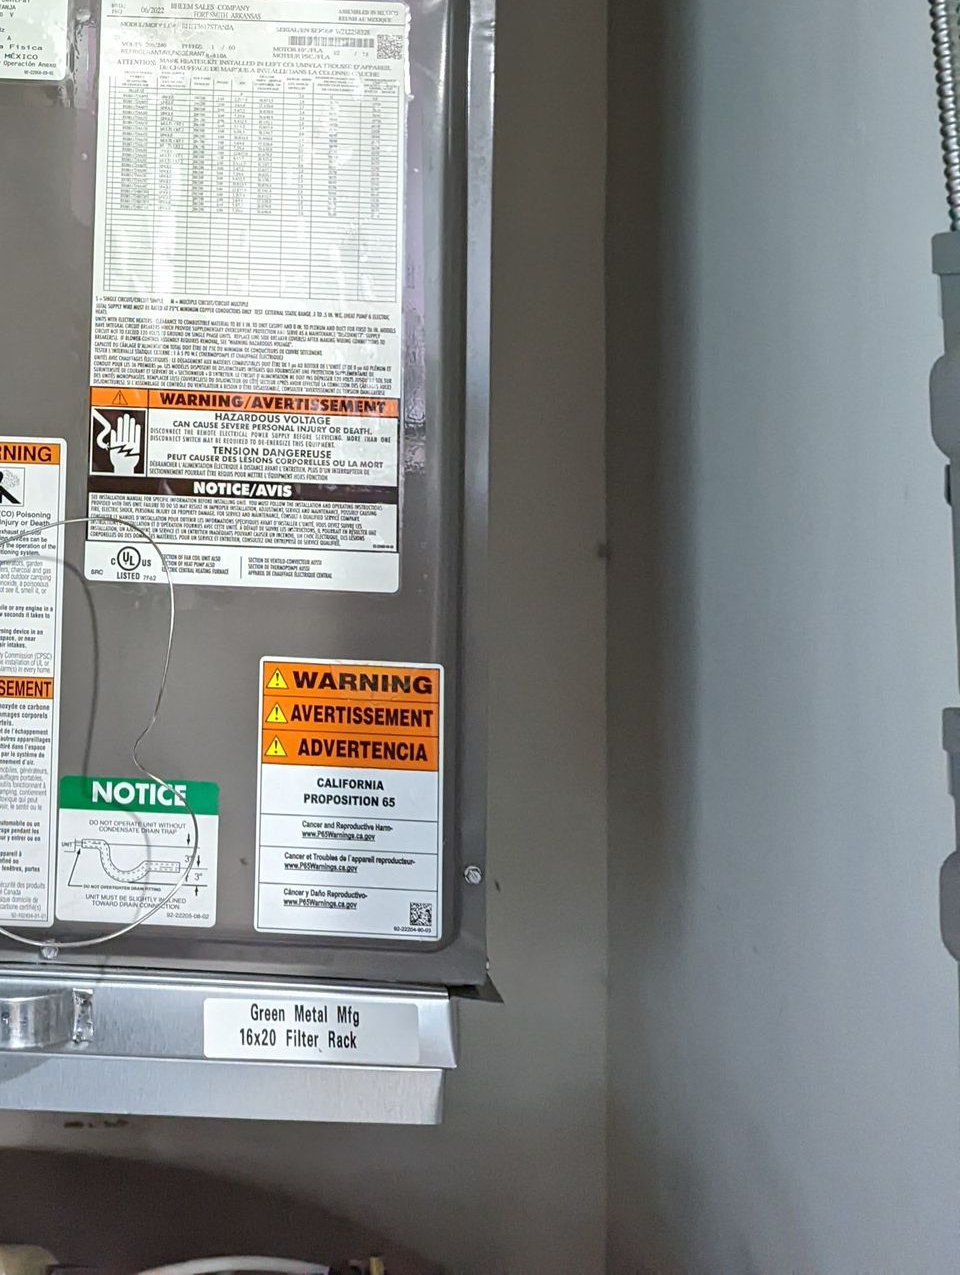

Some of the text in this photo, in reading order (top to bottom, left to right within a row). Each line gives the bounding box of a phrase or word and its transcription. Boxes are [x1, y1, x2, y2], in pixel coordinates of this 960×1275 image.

[160, 393, 386, 413] WARNING/AVERTISSEMENT
[214, 413, 330, 425] HAZARDOUS VOLTAGE
[220, 422, 249, 430] SEVERE
[252, 423, 294, 431] PERSONAL
[297, 425, 326, 433] INJURY
[213, 446, 331, 459] TENSION DANGEREUSE
[275, 457, 329, 466] CORPORELLES
[332, 459, 345, 467] OU
[360, 460, 382, 468] MORT
[193, 482, 292, 497] NOTICE/AVIS
[16, 510, 51, 520] Poisoning
[117, 572, 140, 580] LISTED
[293, 671, 433, 694] WARNING
[291, 704, 433, 727] AVERTISSEMENT
[298, 738, 428, 761] ADVERTENCIA
[317, 778, 384, 791] CALIFORNIA
[92, 781, 186, 806] NOTICE
[304, 793, 395, 807] PROPOSITION 65
[302, 820, 322, 828] Cancer
[324, 821, 335, 829] and
[335, 821, 374, 830] Reproductive
[302, 831, 375, 841] www.P65Warnings.ca.gov
[284, 851, 304, 859] Cancer
[313, 853, 338, 861] Troubles
[284, 863, 358, 873] www.P65Warnings.ca.gov
[310, 889, 325, 897] Daño
[283, 899, 357, 909] www.P65Warnings.ca.gov
[250, 1004, 360, 1027] Green Metal Mfg
[240, 1028, 357, 1049] 16x20 Filter Rack
